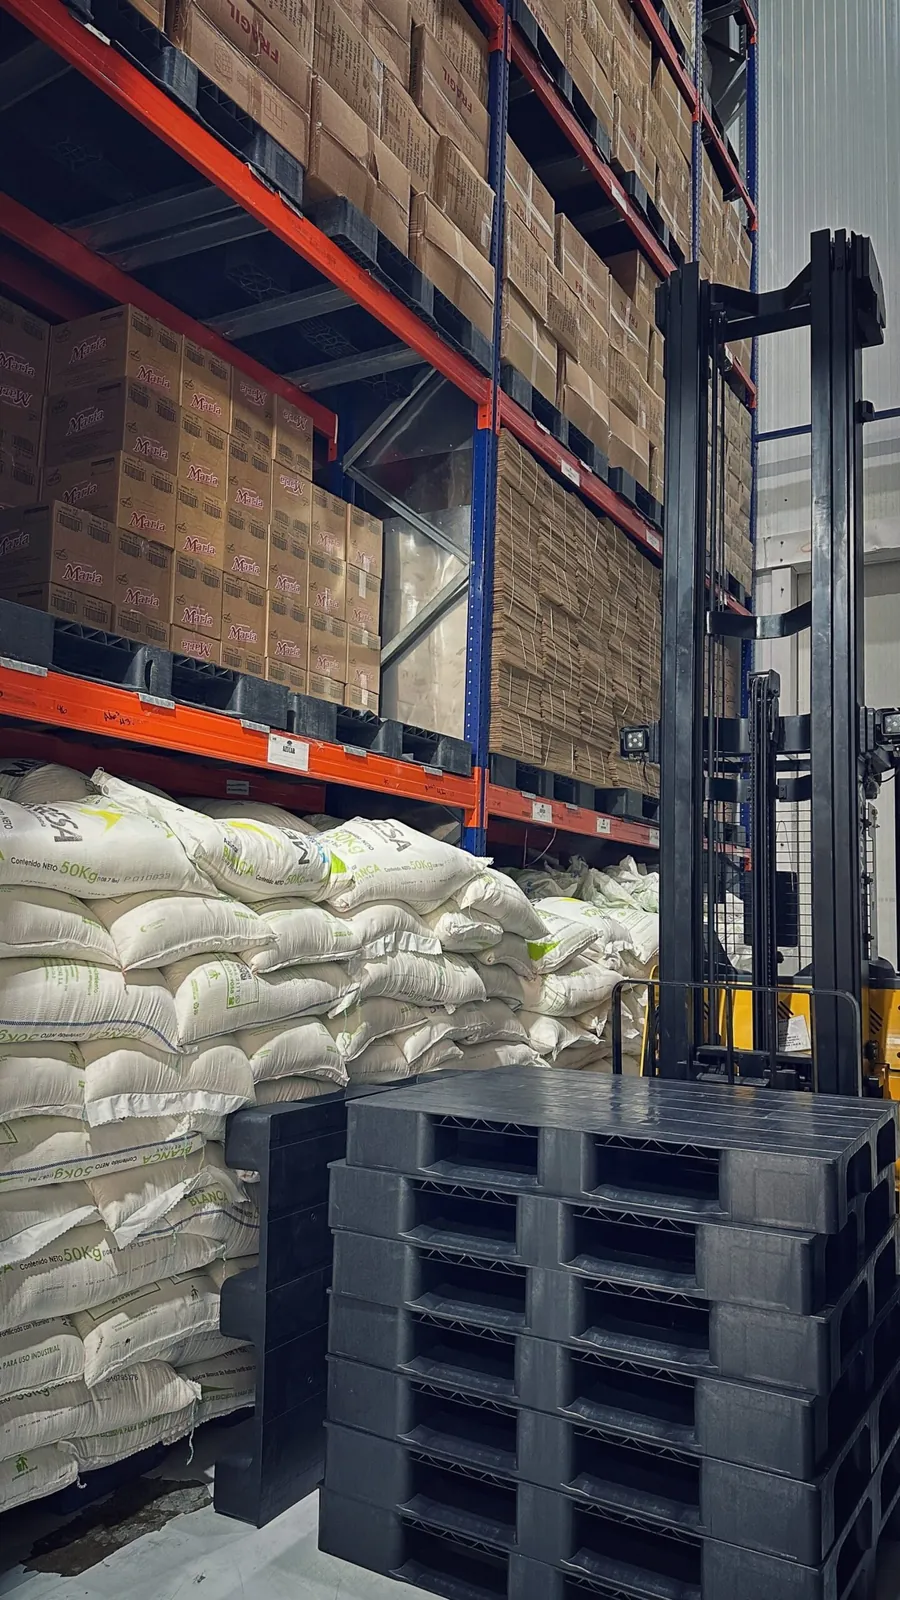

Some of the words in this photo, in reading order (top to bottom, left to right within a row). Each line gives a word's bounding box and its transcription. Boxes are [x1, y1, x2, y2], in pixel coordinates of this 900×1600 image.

[10, 856, 41, 868] Contenido
[42, 861, 58, 872] NETO
[59, 860, 99, 884] 50Kg
[53, 1166, 94, 1180] 50Kg
[19, 1256, 48, 1271] Contenido
[63, 1244, 102, 1263] 50Kg
[2, 1358, 18, 1368] PARA
[18, 1353, 29, 1365] USO
[30, 1344, 61, 1360] INDUSTRIAL
